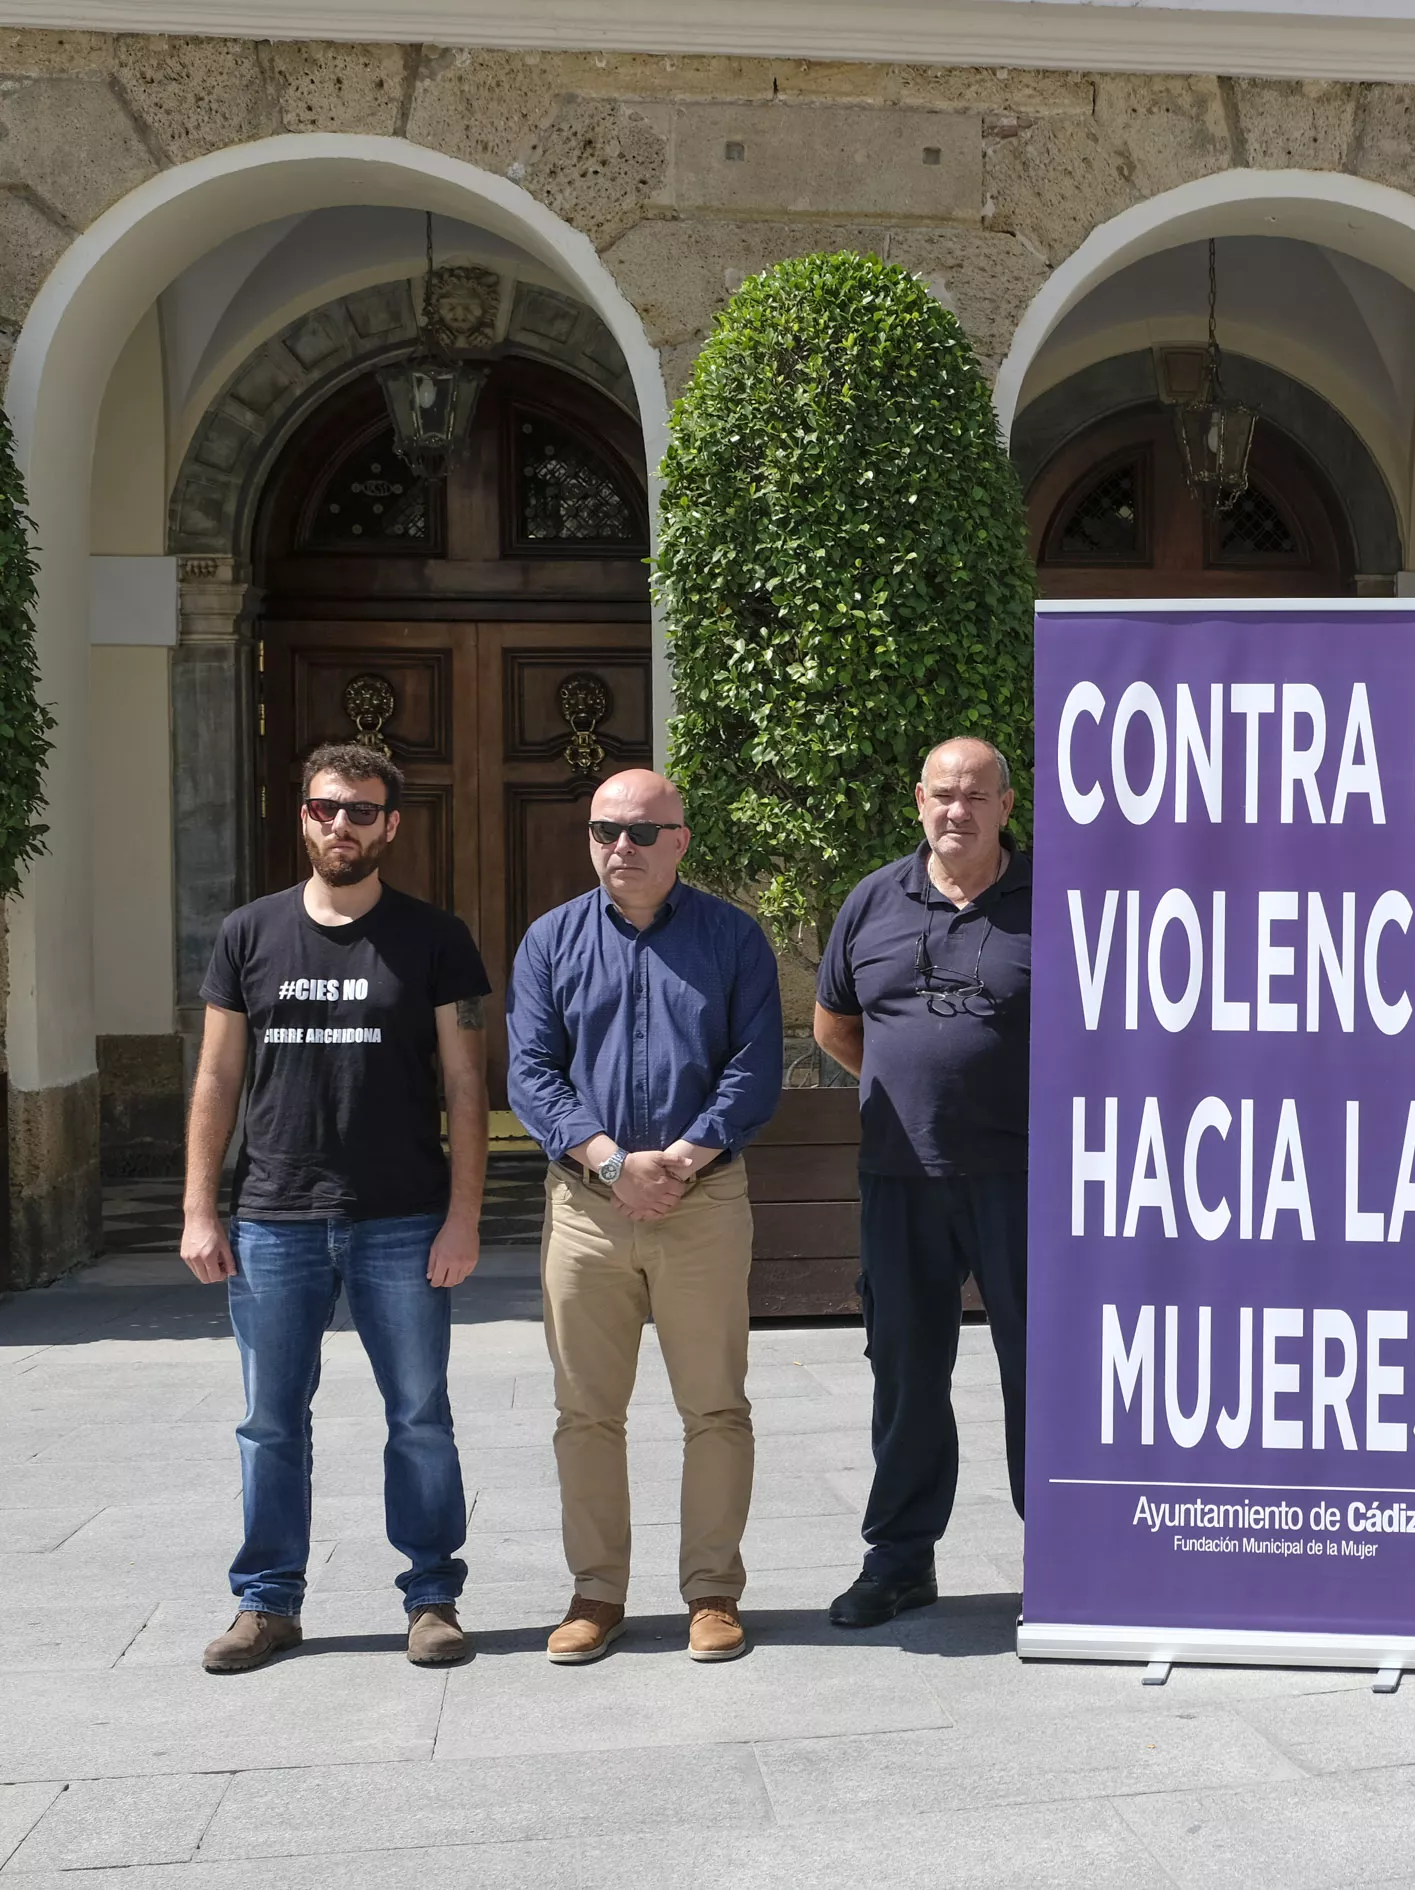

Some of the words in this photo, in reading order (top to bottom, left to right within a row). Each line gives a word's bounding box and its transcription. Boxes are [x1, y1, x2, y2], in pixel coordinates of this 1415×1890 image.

[1057, 680, 1386, 826] CONTRA
[278, 978, 340, 1002] #CIES
[342, 977, 369, 1001] NO
[305, 1026, 382, 1044] ARCHIDONA
[1071, 1095, 1316, 1241] HACIA
[1132, 1495, 1304, 1533] Ayuntamiento
[1309, 1500, 1341, 1532] de
[1173, 1535, 1239, 1554] Fundación
[1242, 1537, 1304, 1558] Municipal
[1306, 1539, 1323, 1556] de
[1326, 1539, 1338, 1556] la
[1341, 1540, 1379, 1560] Mujer
